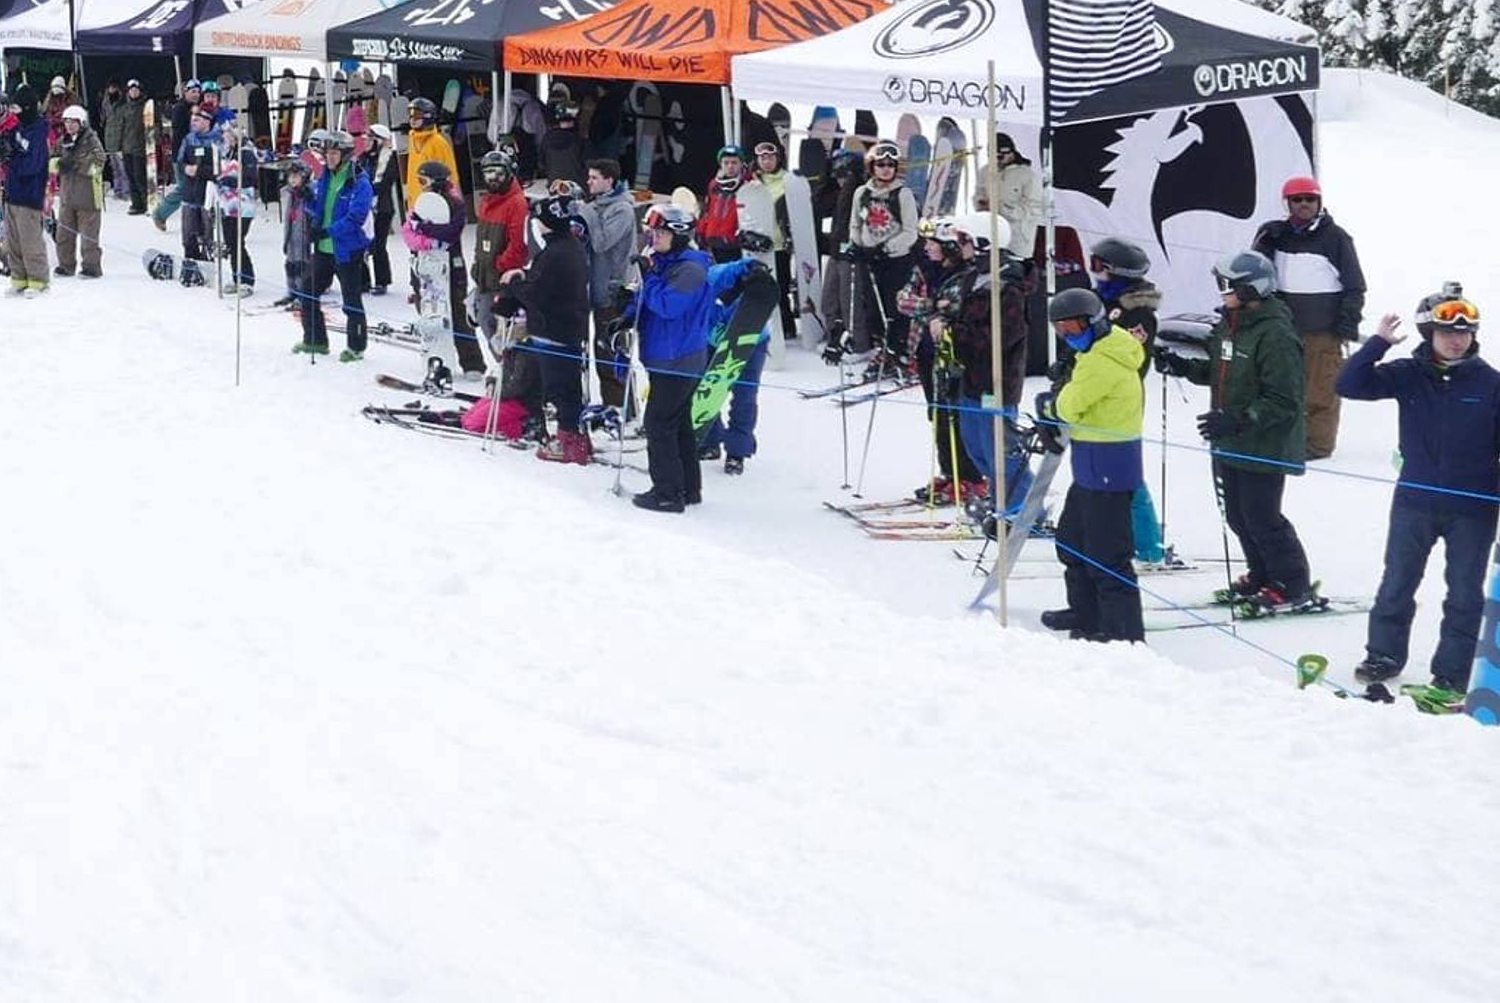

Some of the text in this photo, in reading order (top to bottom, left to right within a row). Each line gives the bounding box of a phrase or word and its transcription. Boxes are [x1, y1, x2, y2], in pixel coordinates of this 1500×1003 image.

[617, 52, 663, 71] WILL
[670, 55, 705, 73] DIE
[1216, 58, 1307, 91] DRAGON
[908, 79, 1026, 111] DRAGON
